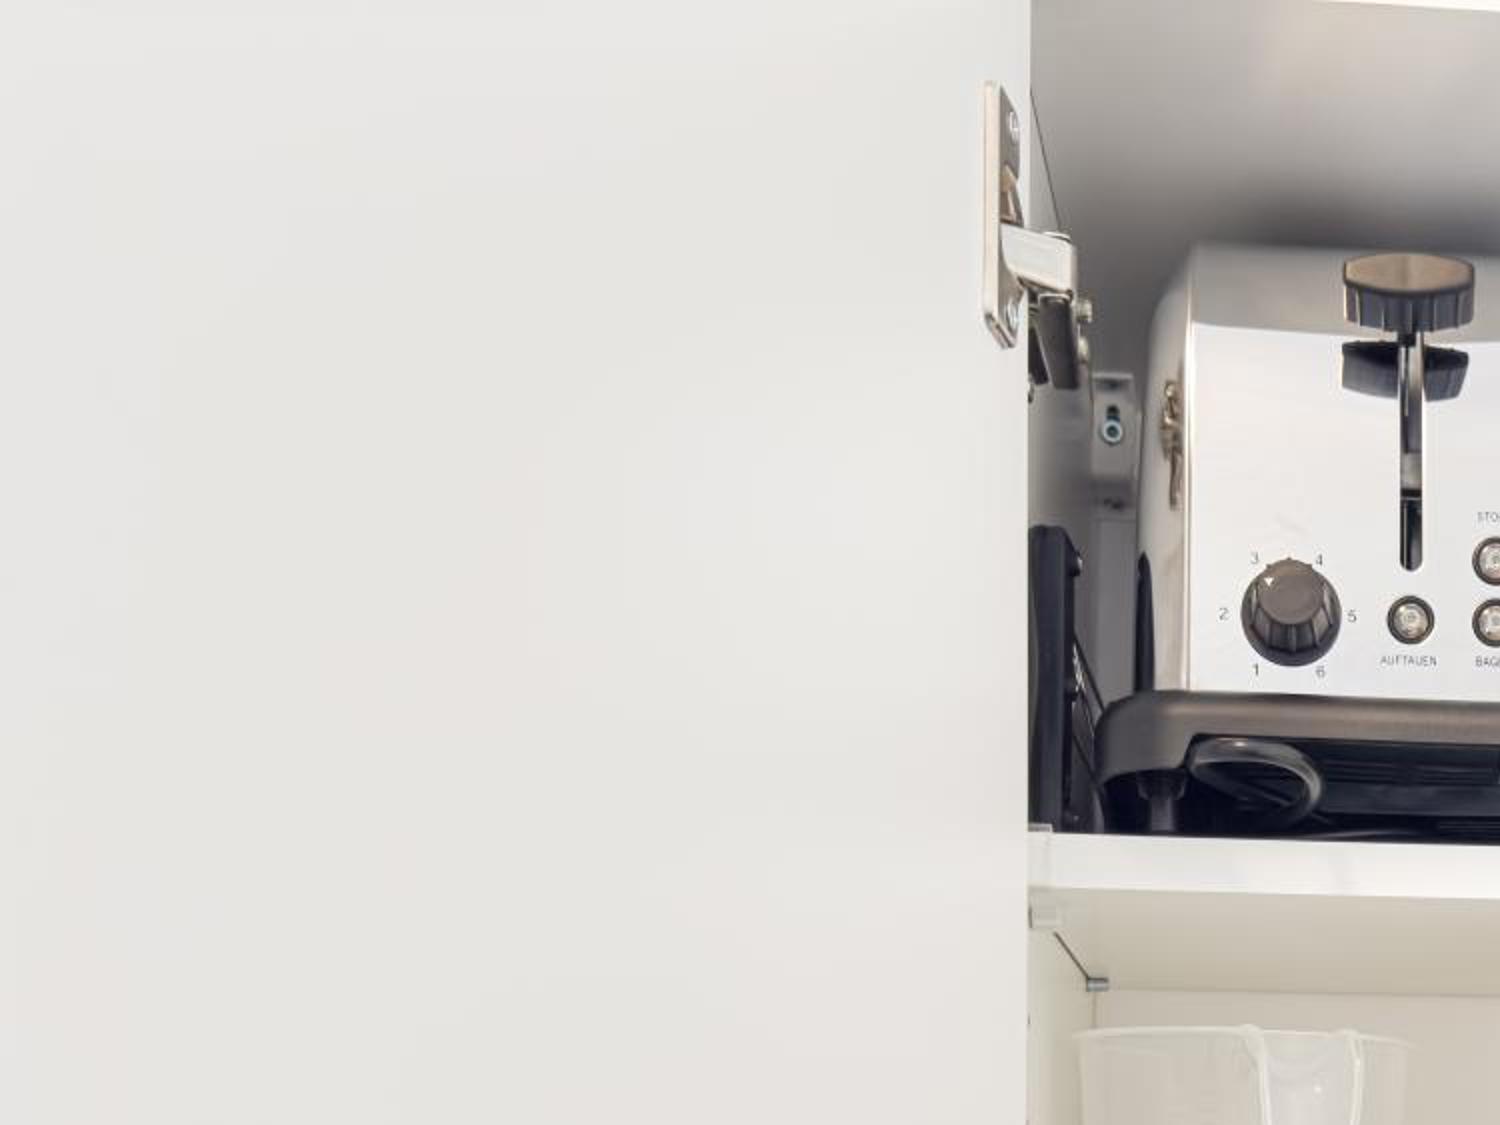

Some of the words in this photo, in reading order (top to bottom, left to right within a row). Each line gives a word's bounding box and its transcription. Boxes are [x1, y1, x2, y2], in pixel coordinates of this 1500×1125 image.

[1250, 551, 1259, 565] 3
[1315, 553, 1324, 566] 4
[1218, 607, 1230, 621] 2
[1347, 609, 1358, 623] 5
[1380, 655, 1438, 667] AUFTAUEN
[1252, 663, 1259, 676] 1
[1315, 666, 1326, 678] 6
